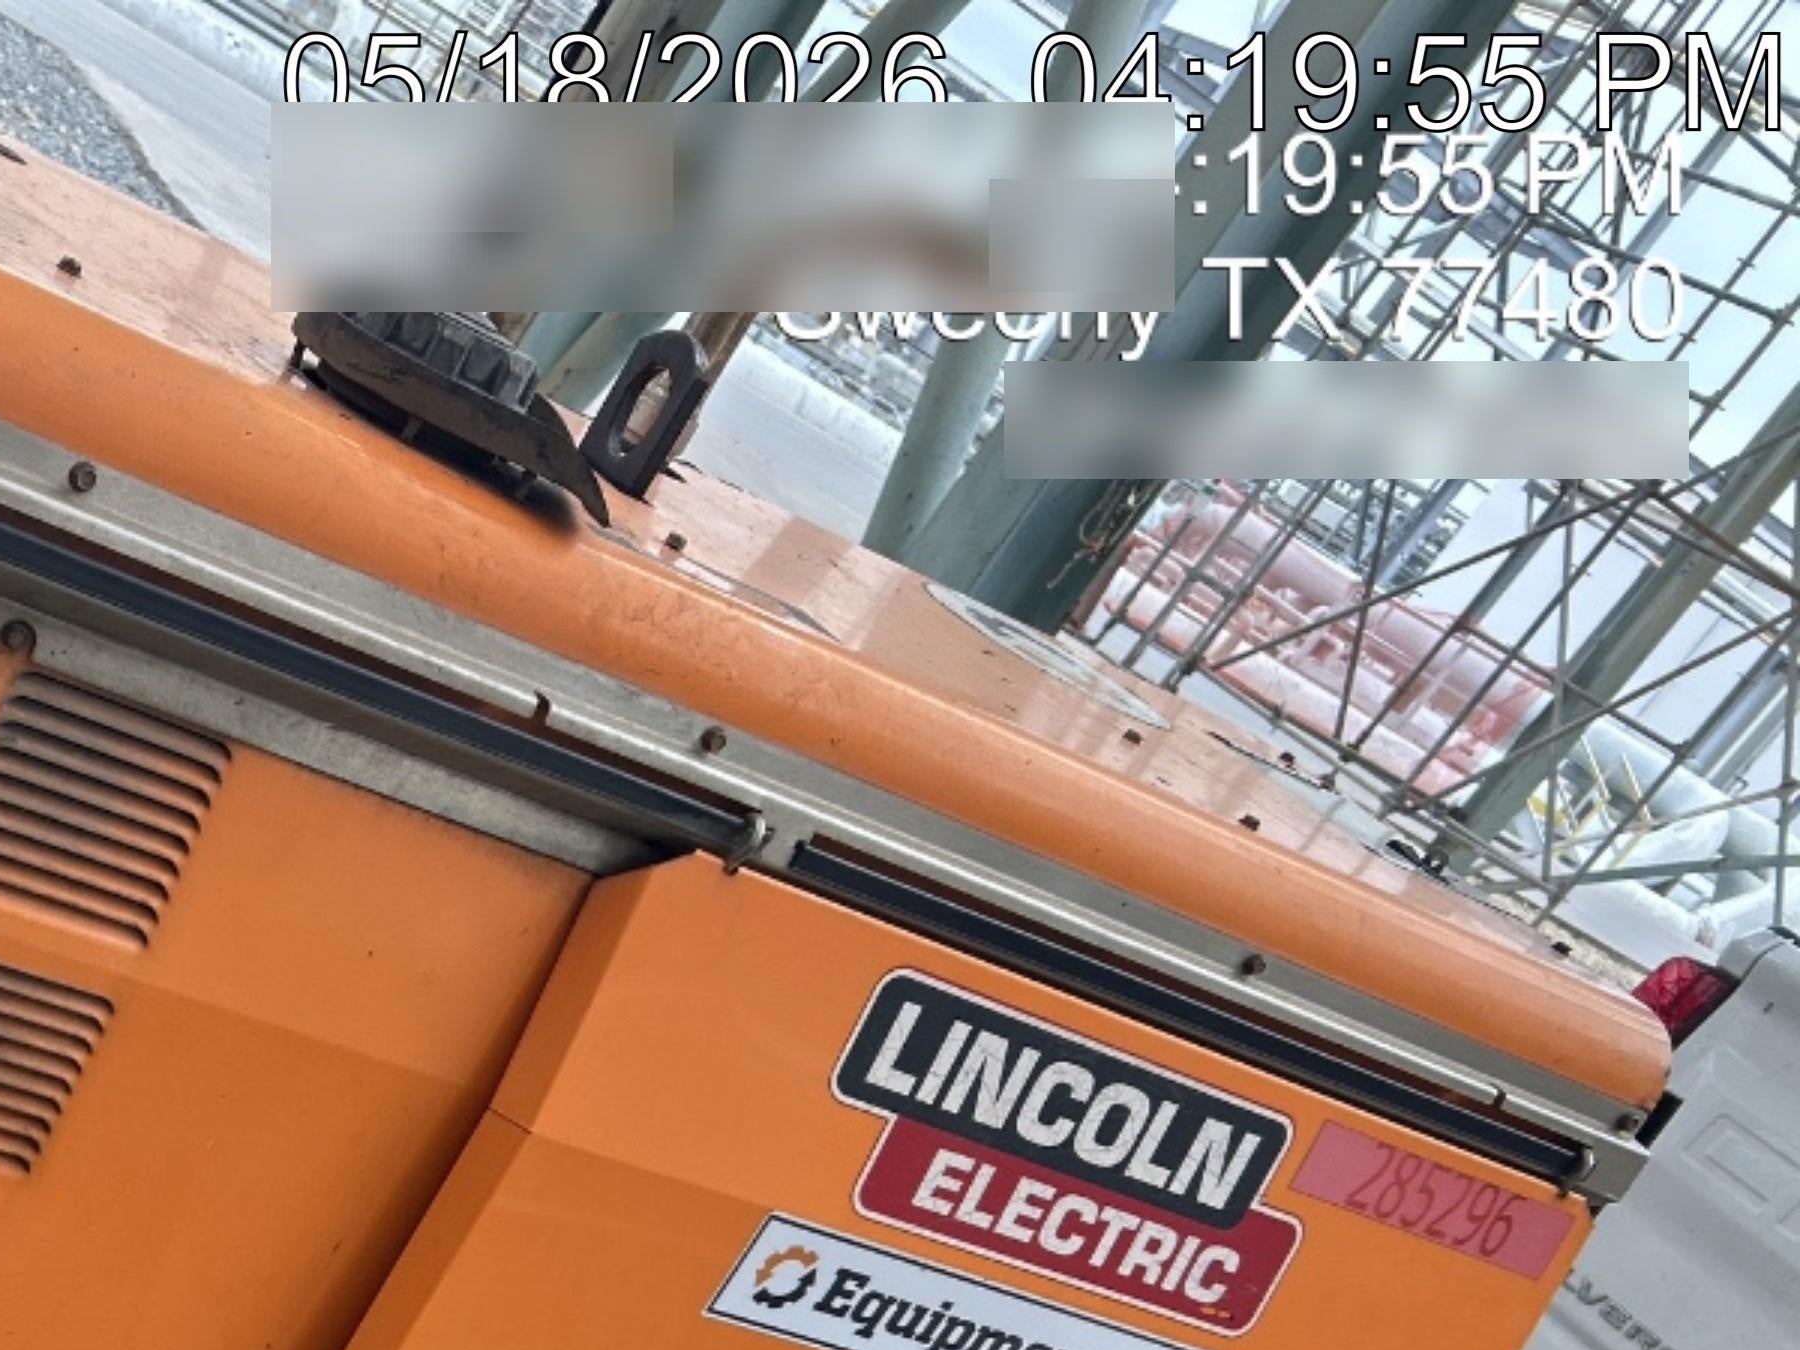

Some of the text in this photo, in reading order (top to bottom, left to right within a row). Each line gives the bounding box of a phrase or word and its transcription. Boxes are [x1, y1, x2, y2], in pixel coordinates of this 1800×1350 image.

[865, 1001, 1261, 1211] LINCOLN
[911, 1148, 1240, 1303] ELECTRIC
[1343, 1142, 1514, 1258] 285296
